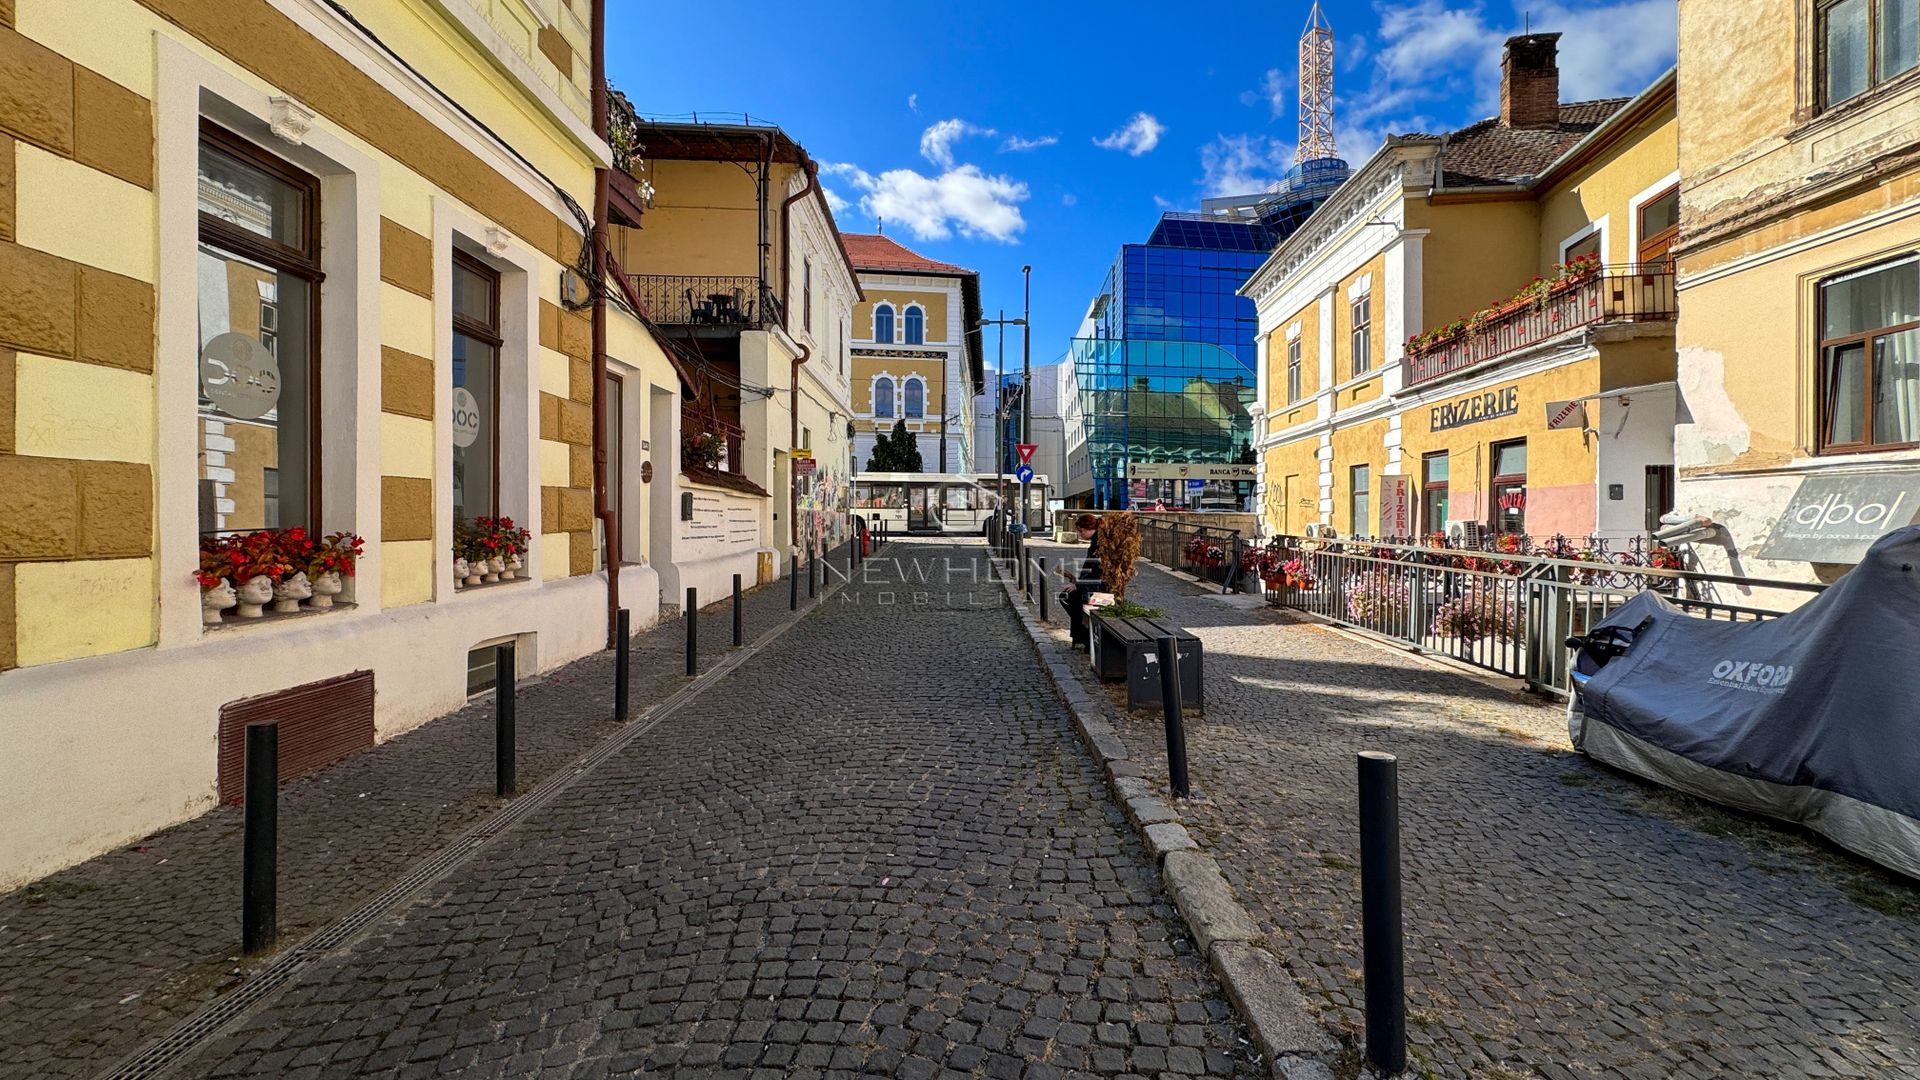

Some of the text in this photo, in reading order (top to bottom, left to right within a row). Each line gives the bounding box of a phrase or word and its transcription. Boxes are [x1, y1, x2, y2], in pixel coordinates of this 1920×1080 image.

[1550, 401, 1578, 428] FRIZERIE
[1813, 531, 1826, 541] by
[1712, 660, 1794, 687] OXFORD
